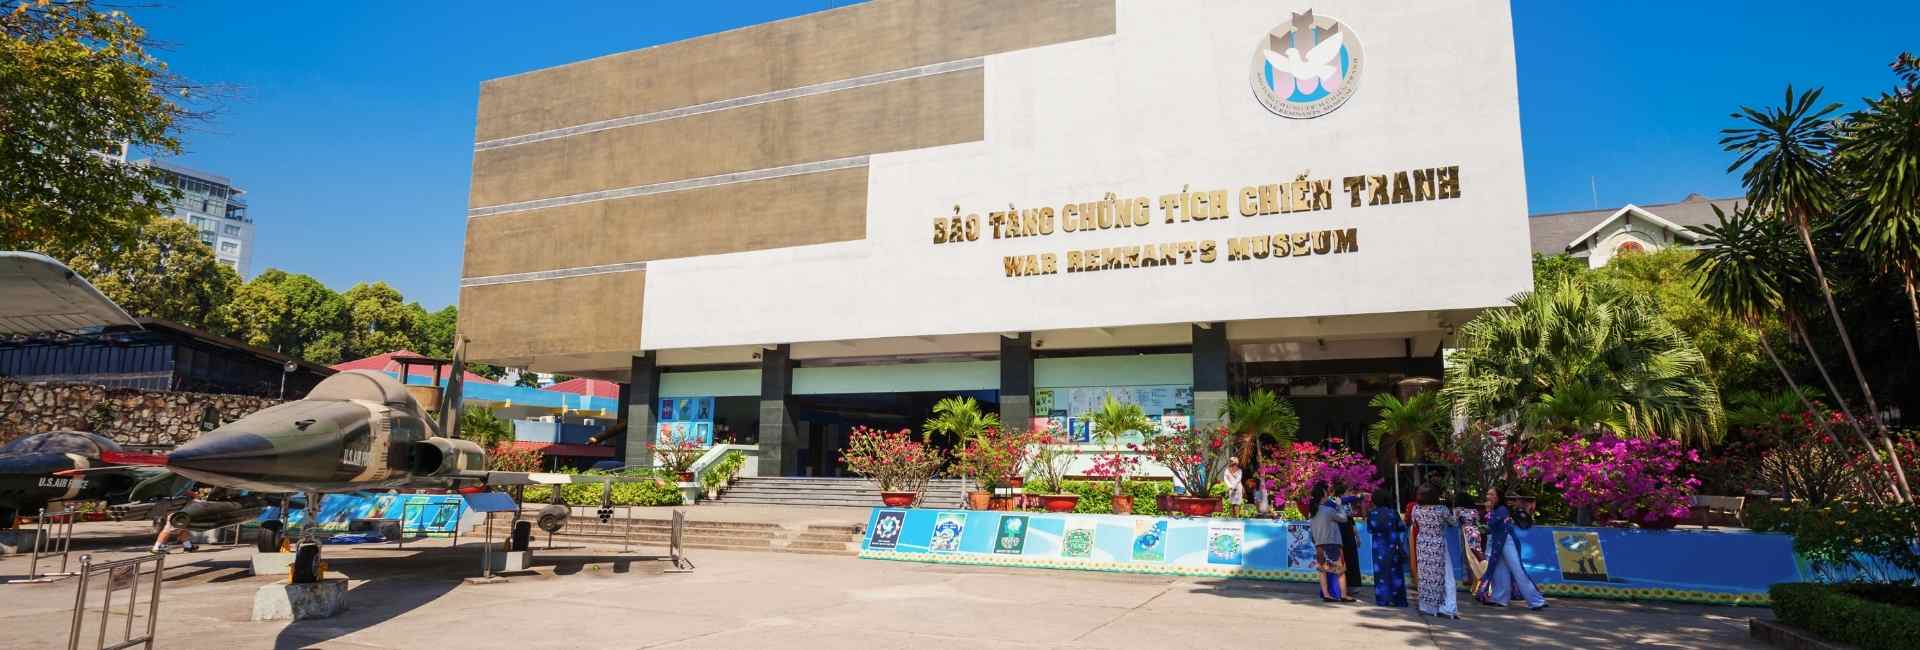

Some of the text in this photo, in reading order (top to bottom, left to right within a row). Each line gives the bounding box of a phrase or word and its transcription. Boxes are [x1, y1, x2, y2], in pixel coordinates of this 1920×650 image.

[933, 166, 1462, 244] BẢO TÀNG CHỨNG TÍCH CHIẾN TRANH
[1003, 228, 1360, 277] WAR REMNANTS MUSEUM
